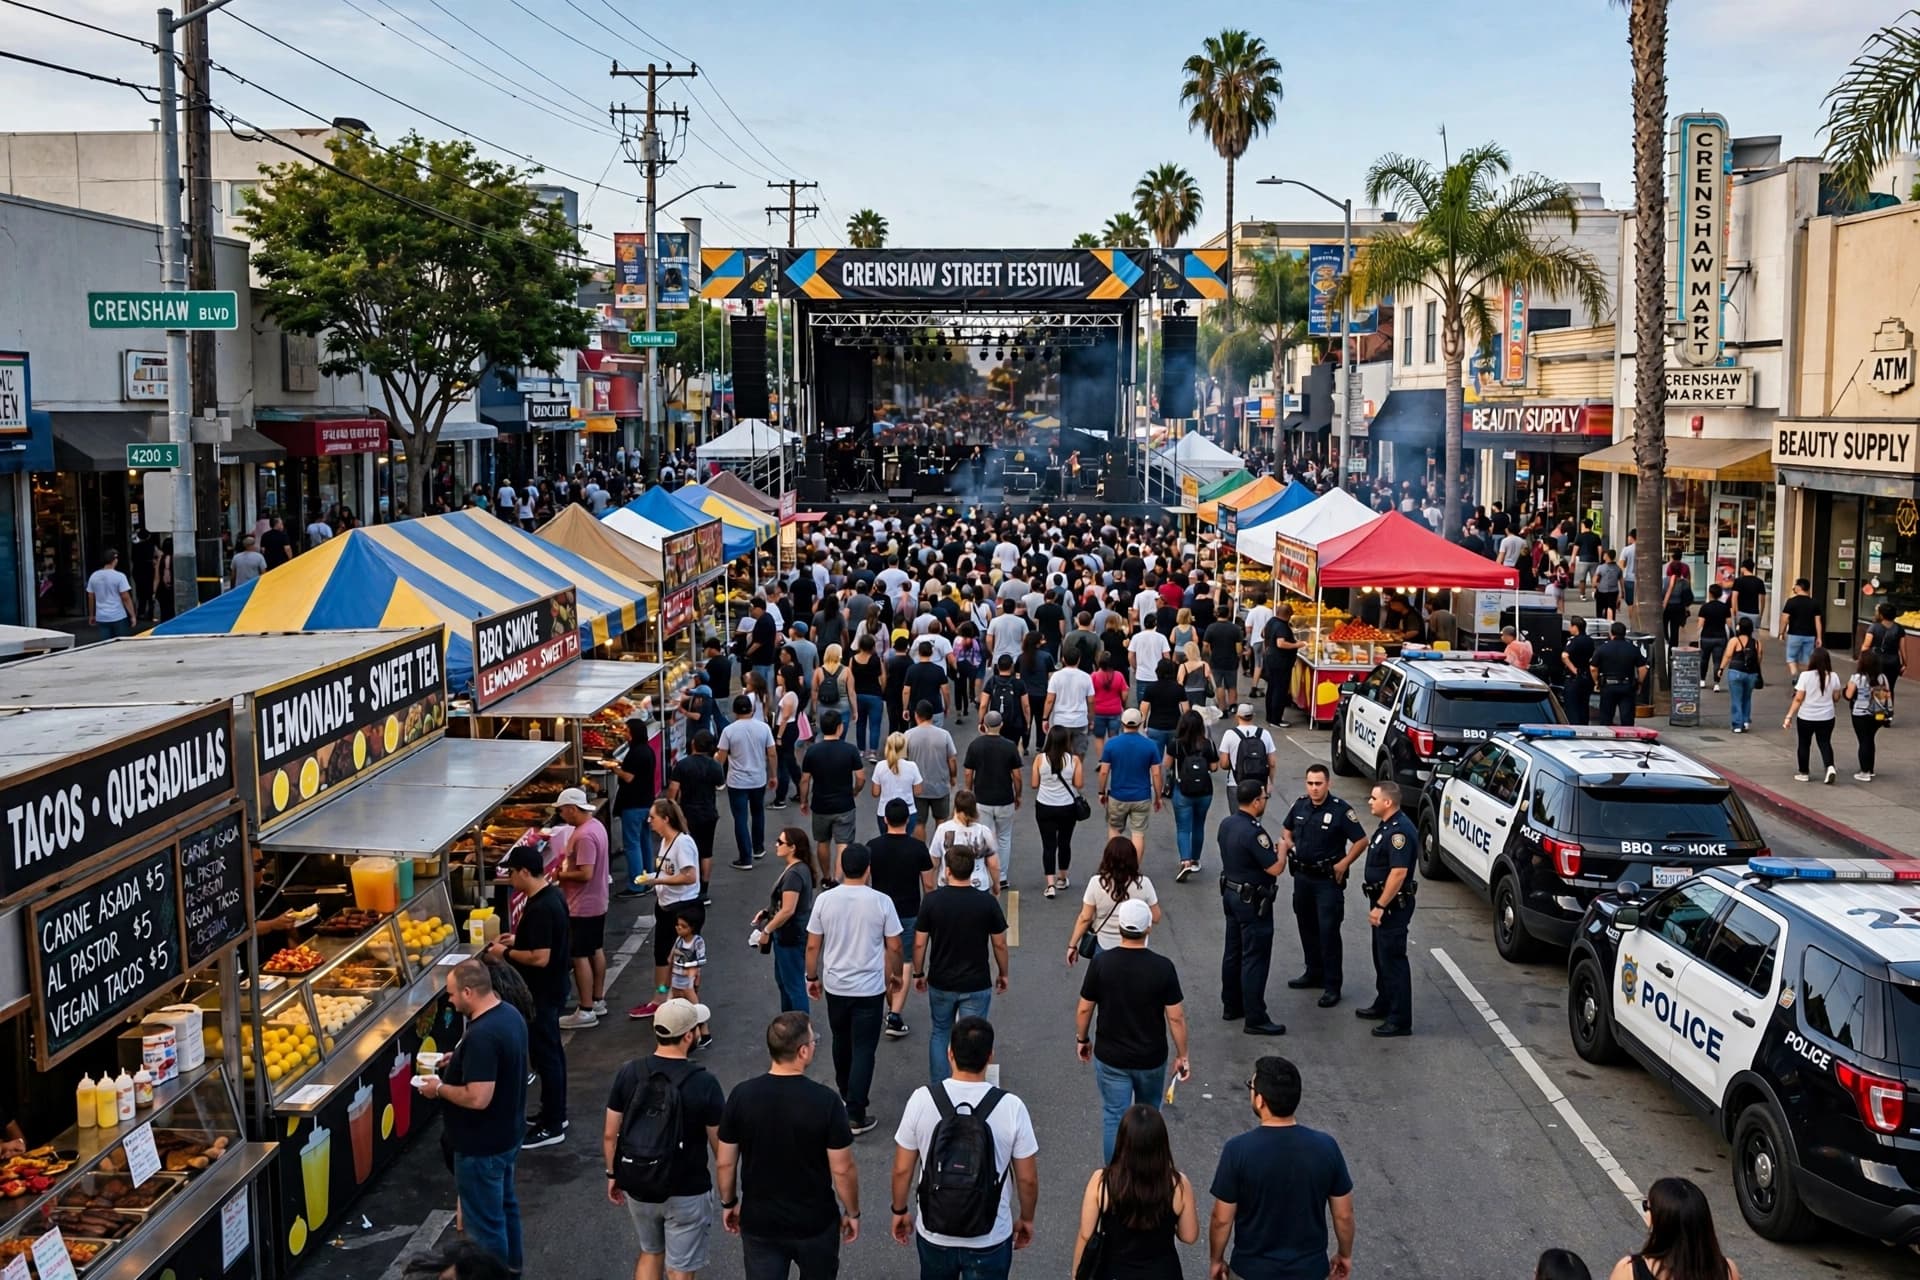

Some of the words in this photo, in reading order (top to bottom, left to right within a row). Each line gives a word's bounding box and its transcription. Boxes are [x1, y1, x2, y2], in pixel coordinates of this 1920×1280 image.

[1691, 132, 1713, 273] CRENSHAW
[842, 263, 937, 287] CRENSHAW
[941, 262, 1002, 287] STREET
[1007, 262, 1084, 286] FESTIVAL
[94, 300, 189, 322] CRENSHAW
[199, 306, 229, 321] BLVD
[1664, 373, 1742, 386] CRENSHAW
[1873, 357, 1908, 380] ATM
[1665, 389, 1737, 400] MARKET
[1472, 407, 1524, 433] BEAUTY
[1525, 407, 1580, 433] SUPPLY
[132, 448, 161, 463] 4200
[166, 451, 172, 463] S
[1779, 430, 1838, 458] BEAUTY
[1844, 432, 1910, 462] SUPPLY
[479, 621, 504, 668] BBQ
[505, 611, 540, 653] SMOKE
[482, 656, 528, 696] LEMONADE
[540, 642, 563, 668] SWEET
[566, 634, 578, 656] TEA
[261, 675, 354, 760] LEMONADE
[369, 650, 414, 712] SWEET
[415, 642, 439, 688] TEA
[1463, 729, 1487, 739] BBQ
[7, 783, 85, 870] TACOS
[107, 727, 226, 828] QUESADILLAS
[1452, 810, 1492, 855] POLICE
[1621, 841, 1653, 855] BBQ
[43, 901, 93, 953] CARNE
[99, 876, 142, 925] ASADA
[146, 863, 165, 893] $5
[47, 965, 67, 998] AL
[70, 931, 121, 983] PASTOR
[133, 910, 152, 940] $5
[50, 984, 99, 1038] VEGAN
[104, 956, 145, 1005] TACOS
[149, 940, 168, 971] $5
[1641, 980, 1724, 1064] POLICE
[1783, 1031, 1832, 1071] POLICE
